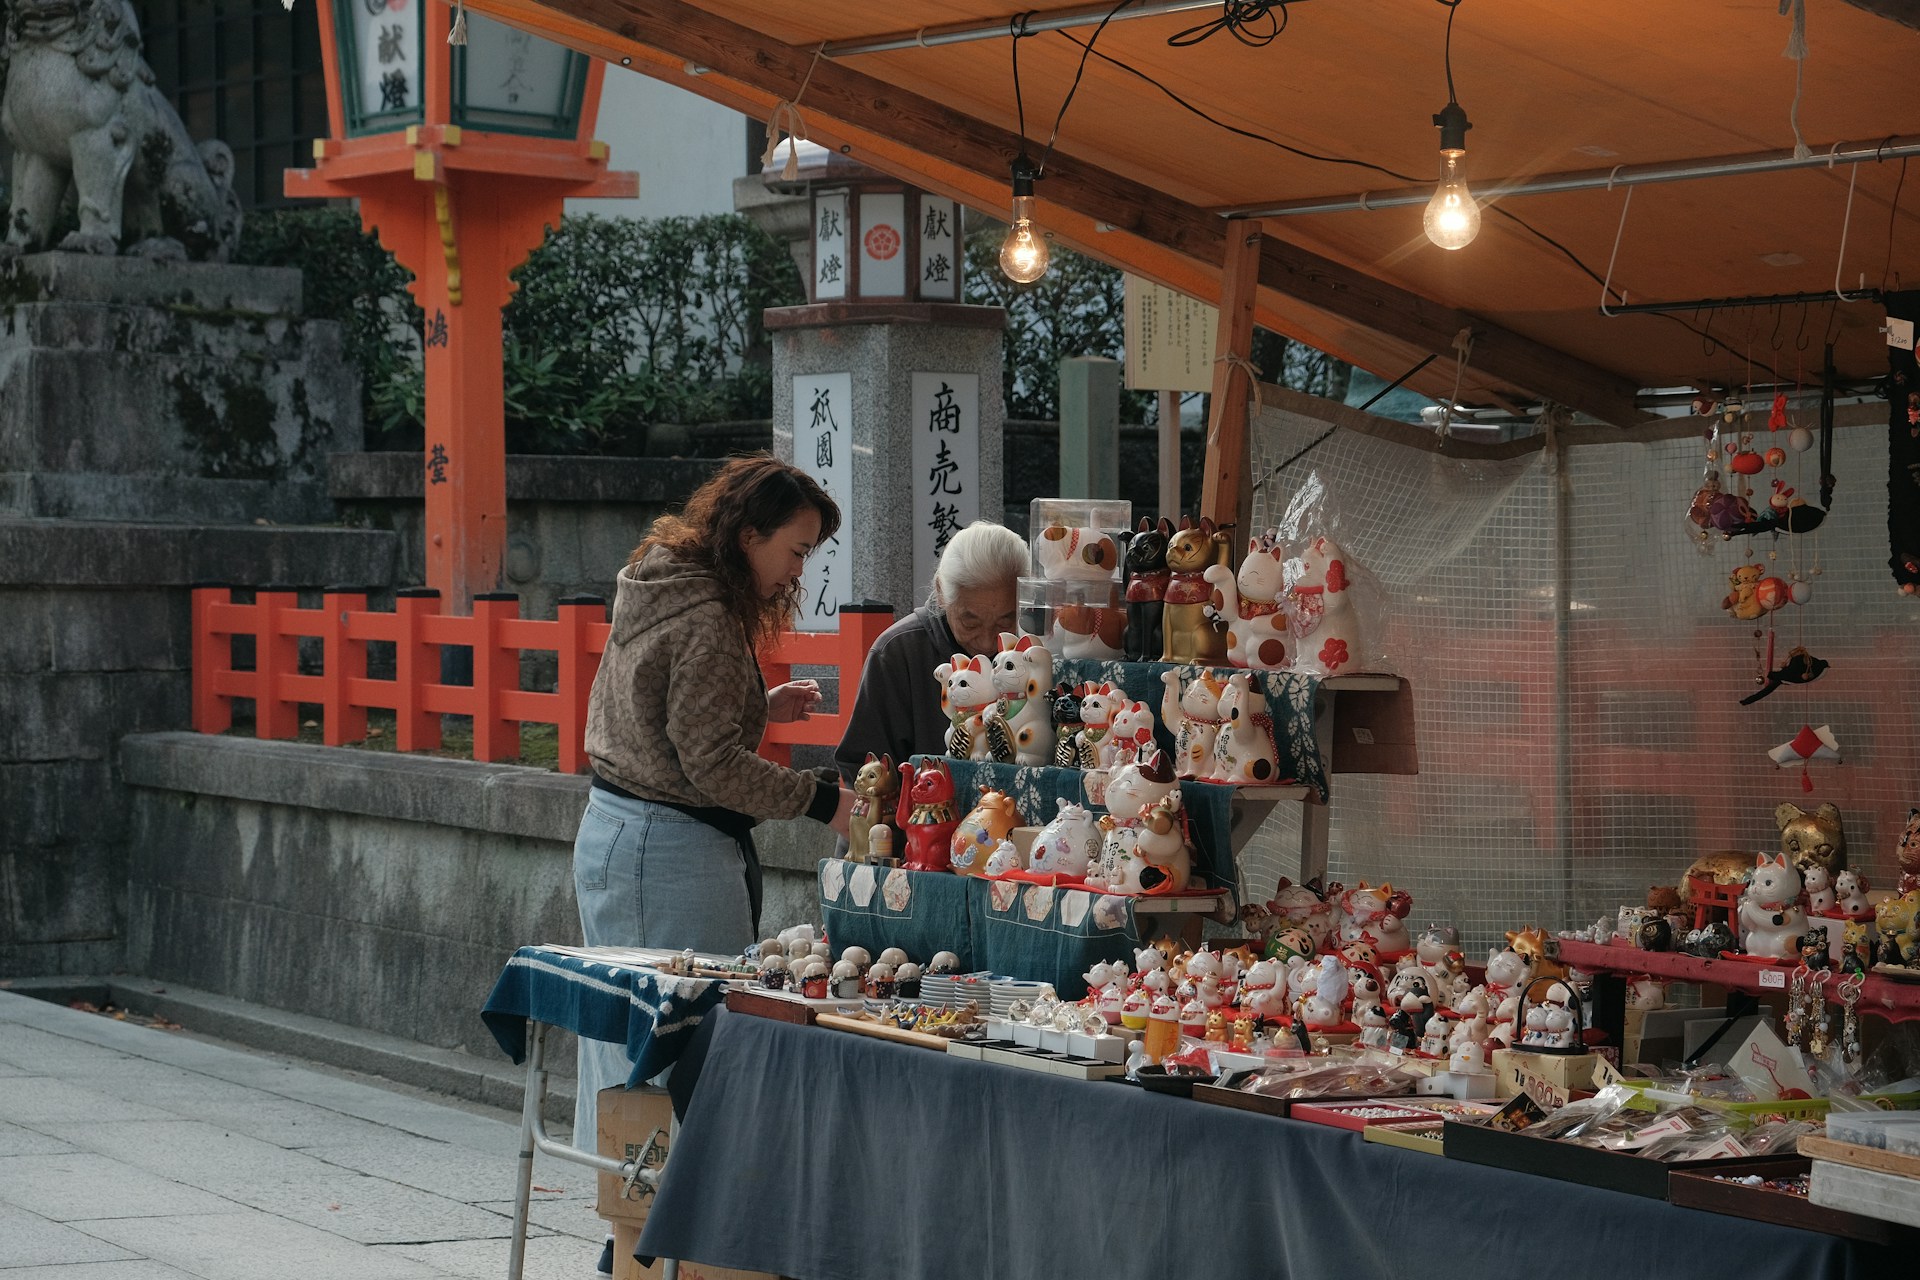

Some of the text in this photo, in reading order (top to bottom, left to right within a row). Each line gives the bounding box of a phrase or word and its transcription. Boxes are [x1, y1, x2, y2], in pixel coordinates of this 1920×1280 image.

[810, 387, 840, 618] 祇園っさん
